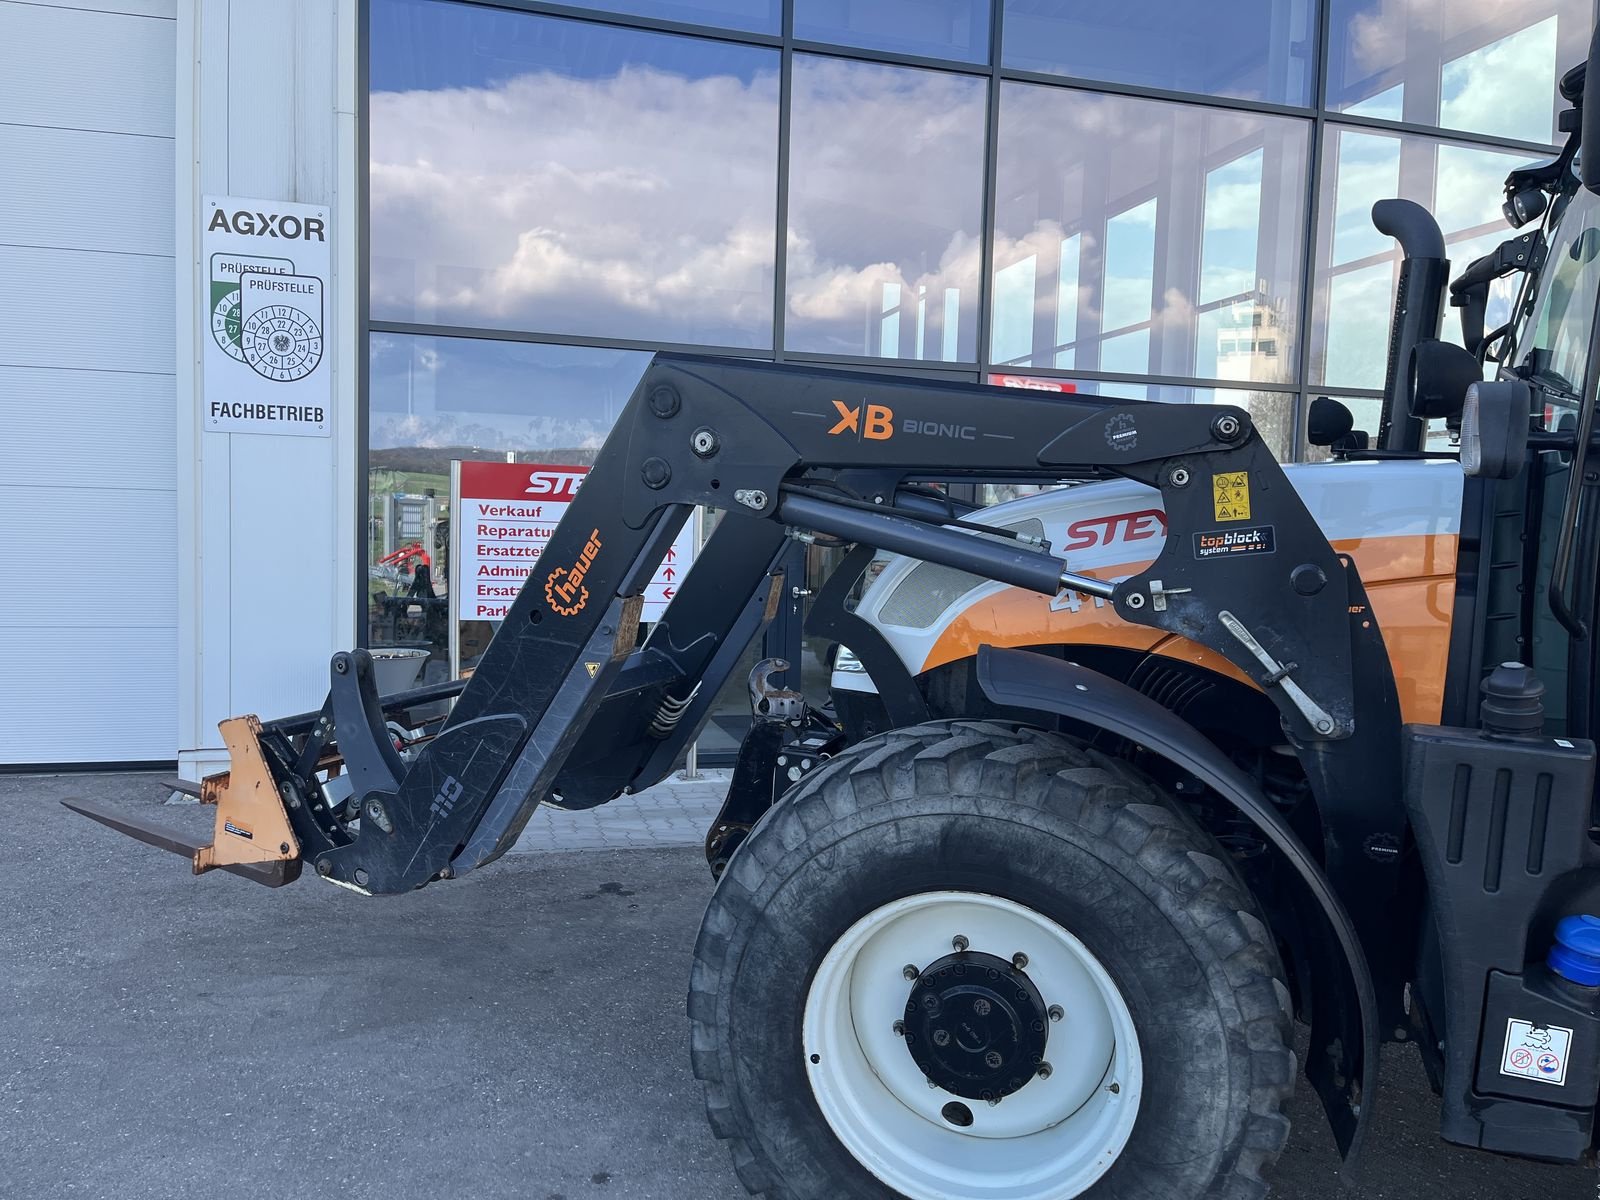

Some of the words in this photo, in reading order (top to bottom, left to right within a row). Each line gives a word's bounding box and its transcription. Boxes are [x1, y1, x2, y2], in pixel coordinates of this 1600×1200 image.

[208, 209, 325, 242] AGXOR
[249, 279, 314, 294] PRÜFSTELLE
[219, 304, 227, 312] 10
[278, 308, 287, 316] 12
[232, 308, 240, 317] 28
[261, 311, 268, 319] 11
[248, 322, 256, 330] 10
[277, 320, 286, 328] 22
[228, 324, 237, 333] 27
[261, 326, 270, 334] 28
[294, 328, 302, 336] 23
[309, 325, 314, 333] 2
[221, 336, 226, 344] 8
[257, 343, 266, 351] 27
[297, 345, 306, 353] 24
[269, 356, 278, 364] 26
[287, 357, 295, 365] 25
[308, 356, 313, 364] 4
[280, 371, 284, 379] 6
[210, 401, 324, 422] FACHBETRIEB
[902, 419, 977, 440] BIONIC
[478, 504, 542, 517] Verkauf
[1200, 530, 1261, 547] topblock
[1200, 546, 1229, 556] system
[554, 528, 602, 603] hauer
